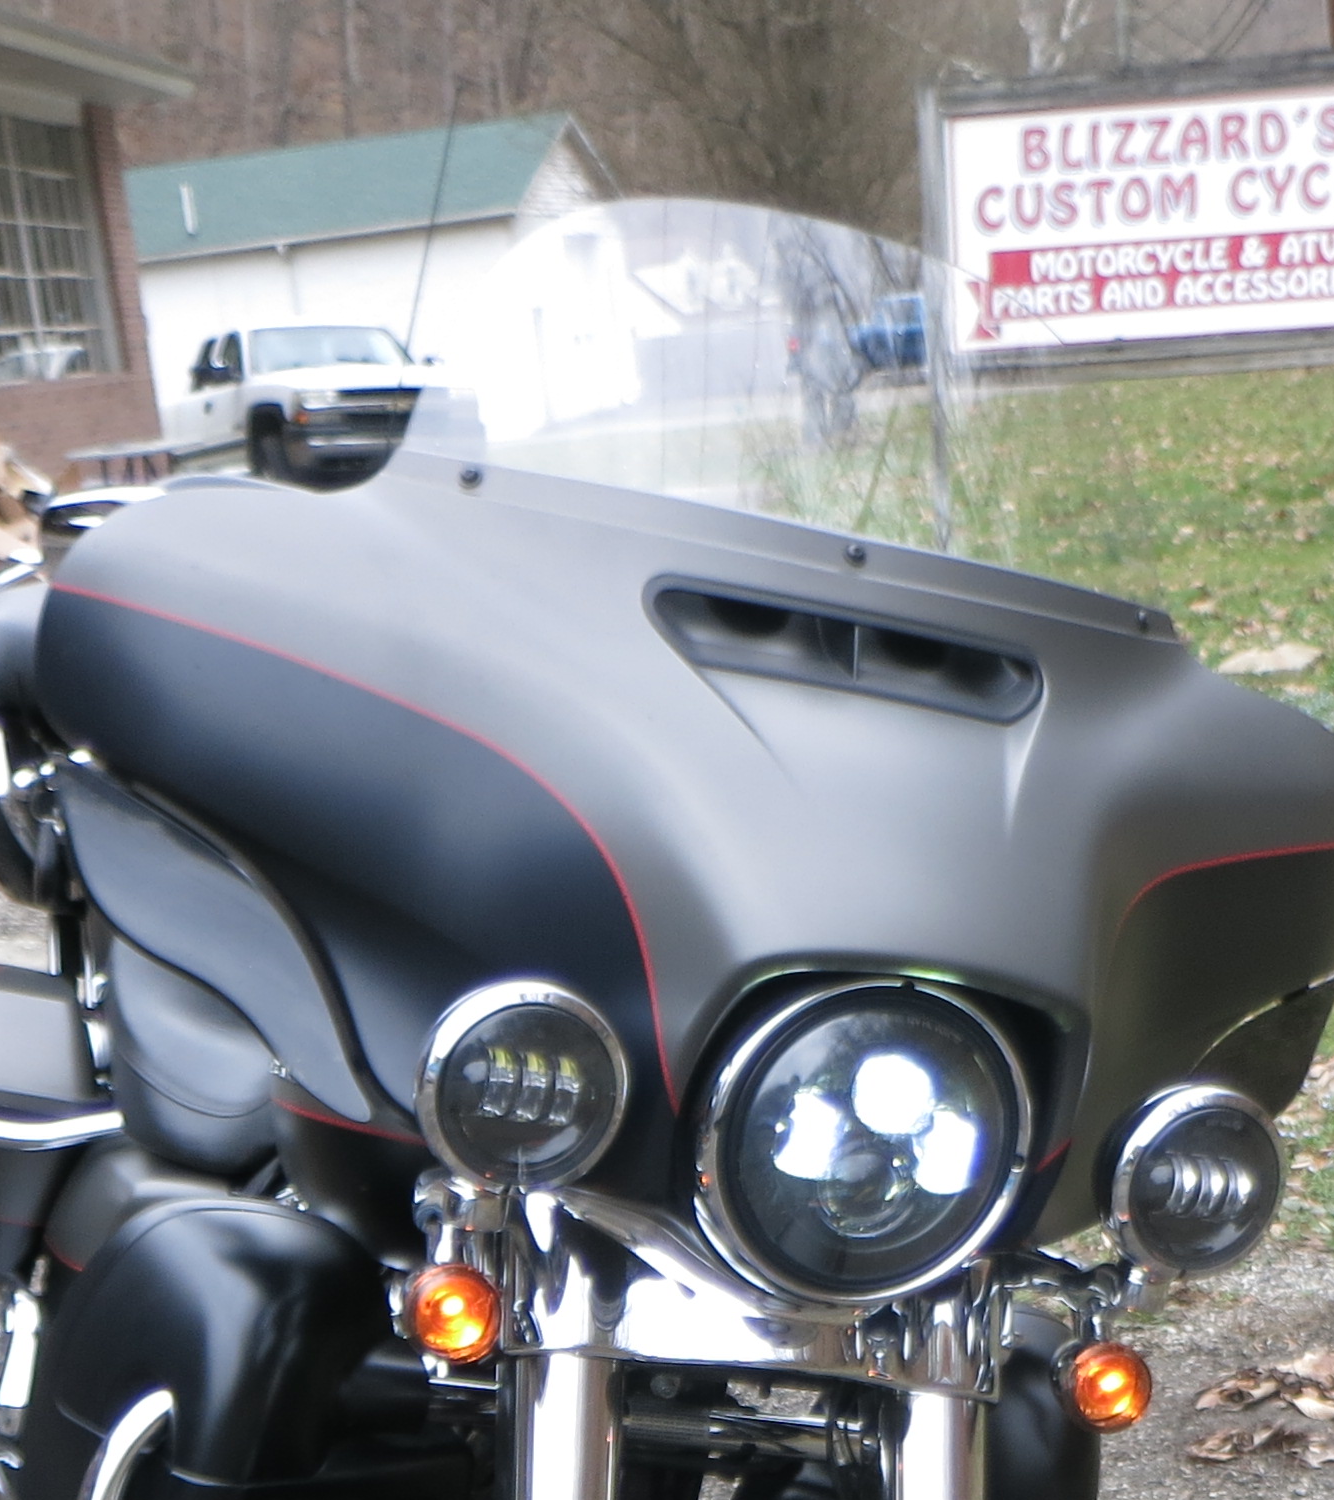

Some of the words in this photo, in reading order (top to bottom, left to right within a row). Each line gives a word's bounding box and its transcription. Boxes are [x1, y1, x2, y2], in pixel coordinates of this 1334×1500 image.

[974, 172, 1199, 234] CUSTOM
[1031, 238, 1228, 282] MOTORCYCLE
[1240, 237, 1269, 268] &
[991, 281, 1091, 319] PARTS
[1101, 277, 1165, 312] AND
